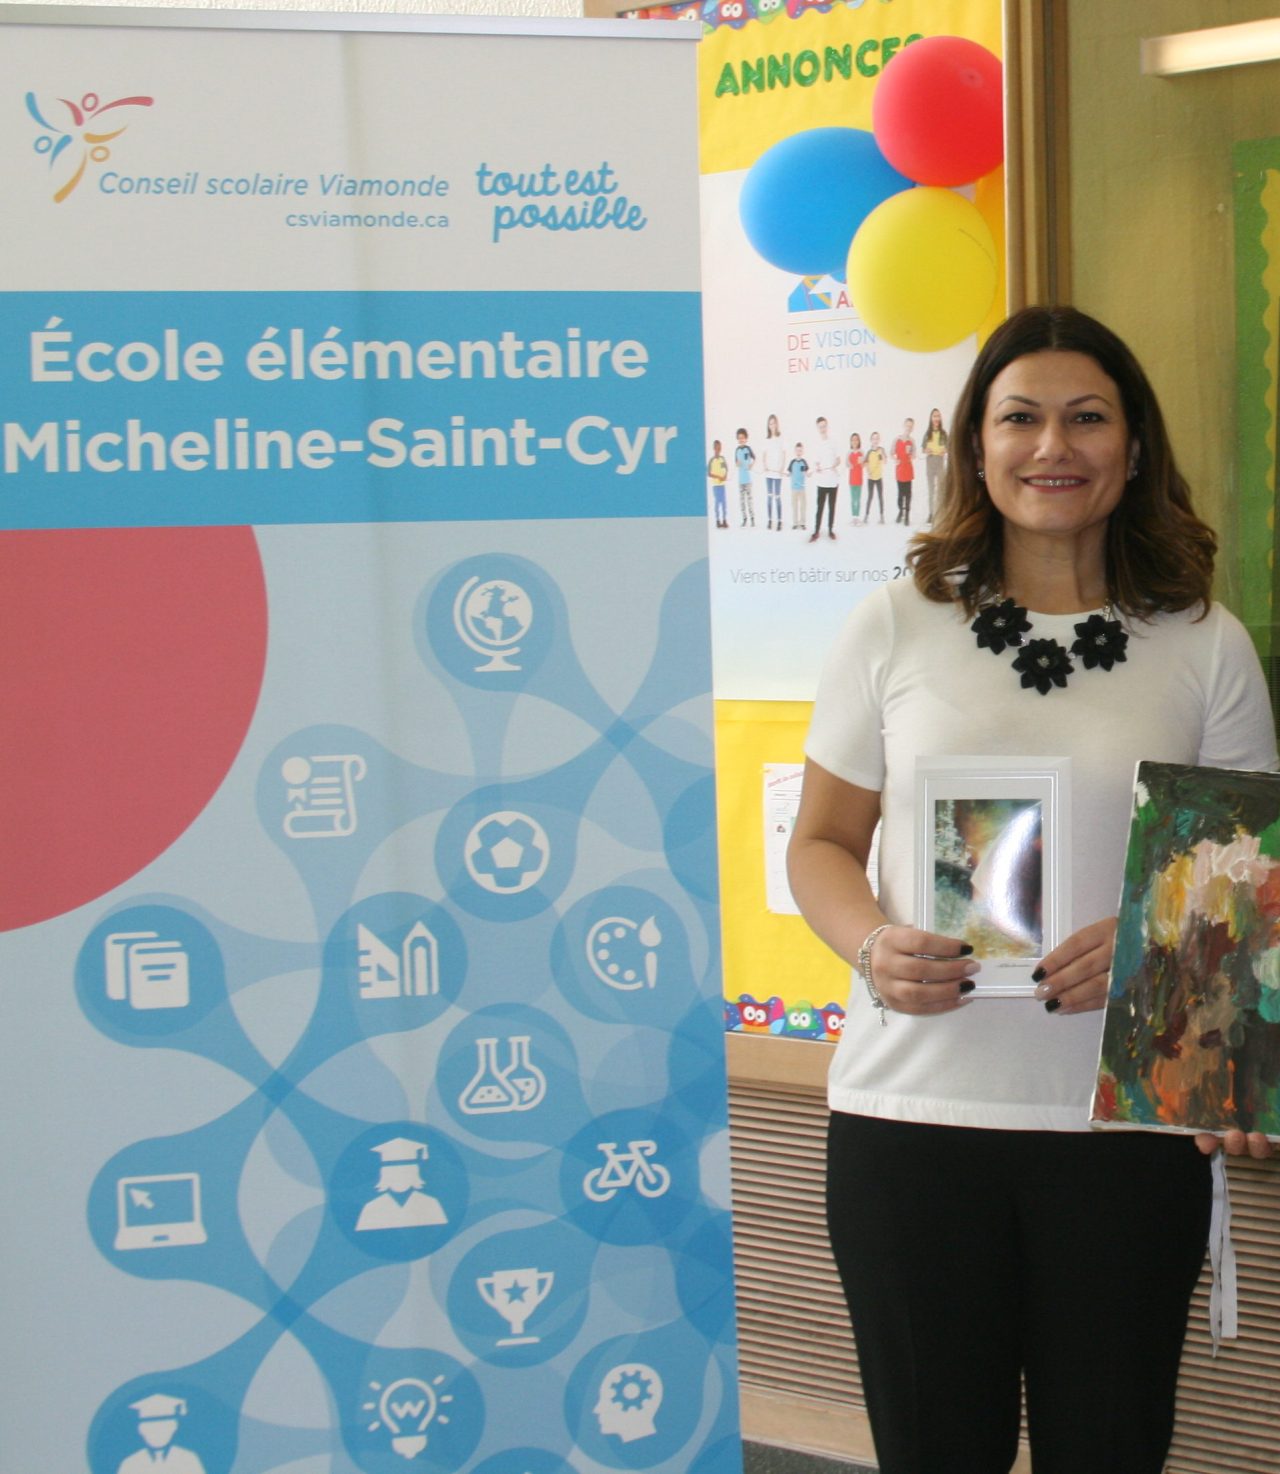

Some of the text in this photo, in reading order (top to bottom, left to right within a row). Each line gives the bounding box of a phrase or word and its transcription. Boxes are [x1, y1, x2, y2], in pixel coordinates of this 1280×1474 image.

[714, 33, 926, 98] ANNONCE
[99, 171, 450, 197] Conseil scolaire Viamonde
[475, 161, 618, 198] tout est
[285, 210, 450, 228] csviamonde.ca
[492, 196, 648, 244] possible
[29, 316, 650, 383] École élémentaire
[787, 328, 876, 351] DE VISION
[788, 351, 877, 374] EN ACTION
[3, 413, 679, 475] Micheline-Saint-Cyr
[730, 567, 767, 584] Viens
[835, 569, 858, 583] sur
[861, 568, 889, 582] nos
